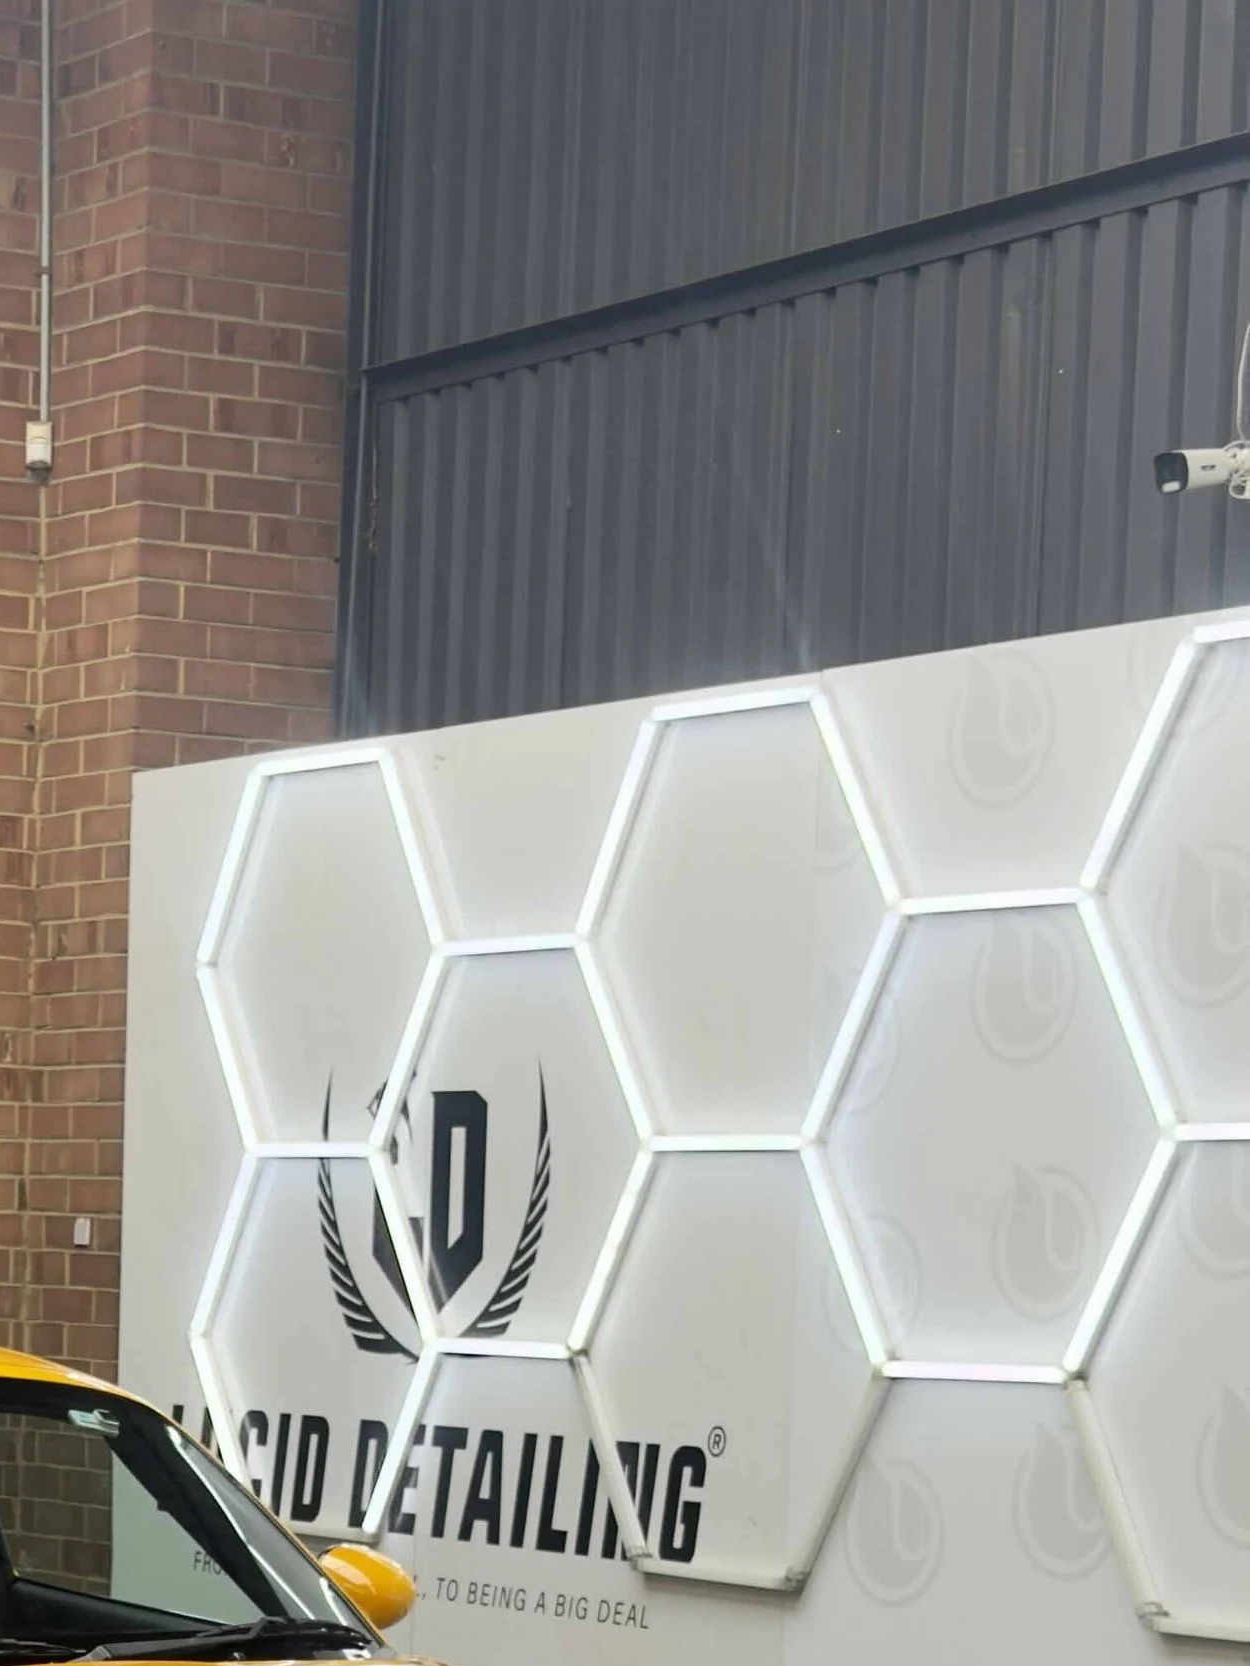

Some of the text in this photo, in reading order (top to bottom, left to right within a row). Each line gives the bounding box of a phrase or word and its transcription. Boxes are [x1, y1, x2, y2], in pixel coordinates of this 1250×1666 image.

[171, 1404, 330, 1523] CID
[194, 1551, 226, 1576] FRO
[436, 1577, 458, 1602] TO
[466, 1582, 527, 1612] BEING
[534, 1592, 546, 1614] A
[554, 1594, 588, 1620] BIG
[597, 1599, 649, 1629] DEAL
